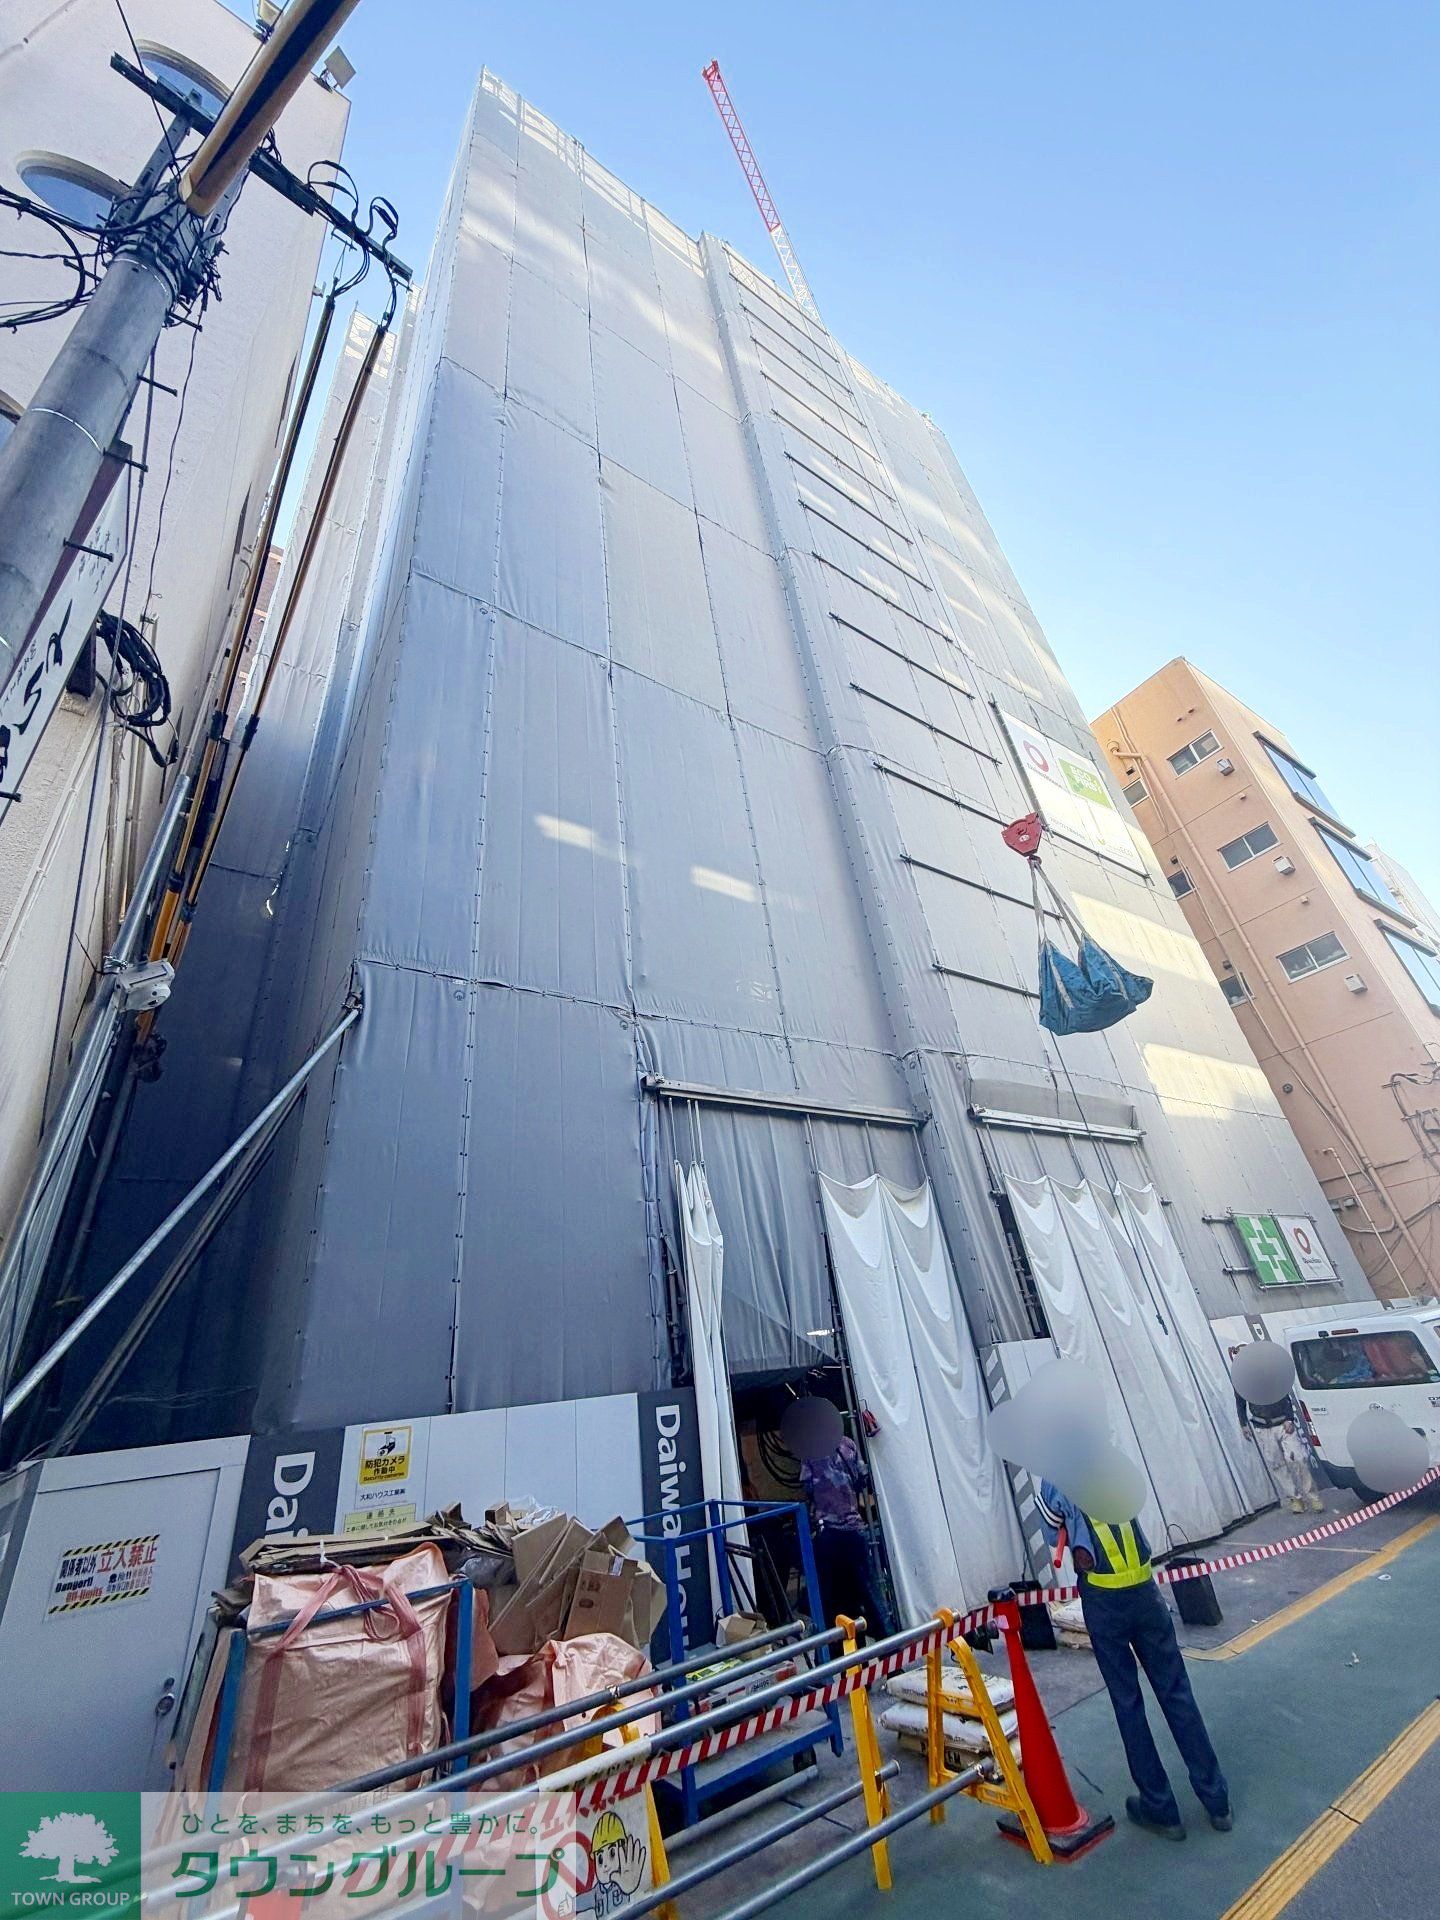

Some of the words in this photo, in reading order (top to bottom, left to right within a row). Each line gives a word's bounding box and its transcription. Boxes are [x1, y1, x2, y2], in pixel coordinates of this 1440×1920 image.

[365, 1455, 405, 1469] 防犯カメラ
[373, 1466, 396, 1476] 作動中
[655, 1404, 686, 1539] Daiwa
[265, 1451, 316, 1539] Dai
[59, 1554, 98, 1580] 関係者以外
[97, 1541, 158, 1574] 立入禁止
